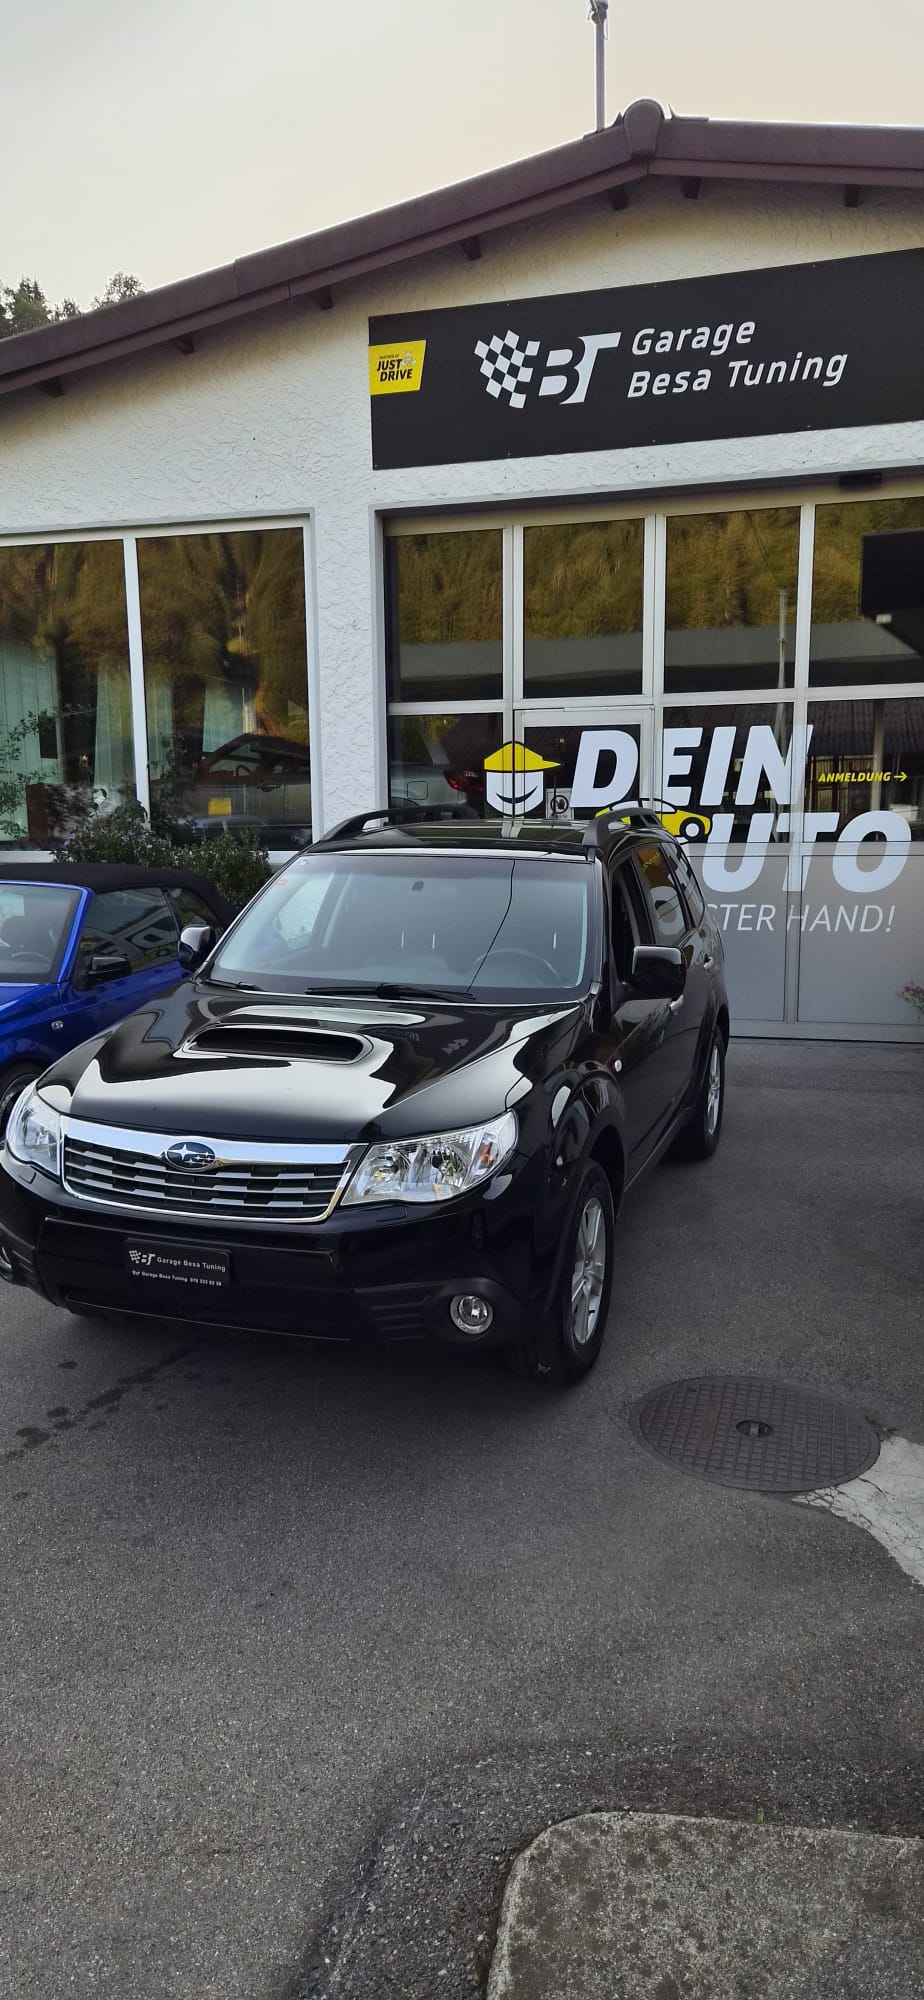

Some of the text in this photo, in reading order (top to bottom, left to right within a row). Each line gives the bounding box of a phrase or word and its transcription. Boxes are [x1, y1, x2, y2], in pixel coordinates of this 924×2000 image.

[631, 321, 756, 356] Garage
[377, 358, 403, 372] JUST
[380, 368, 413, 382] DRIVE
[627, 351, 849, 399] Besa Tuning
[569, 725, 814, 808] DEIN
[818, 771, 892, 783] ANMELDUNG
[683, 810, 912, 893] UTO
[786, 904, 896, 932] HAND!
[157, 1256, 181, 1267] Garage
[183, 1259, 200, 1268] Besa
[202, 1262, 226, 1273] Tuning
